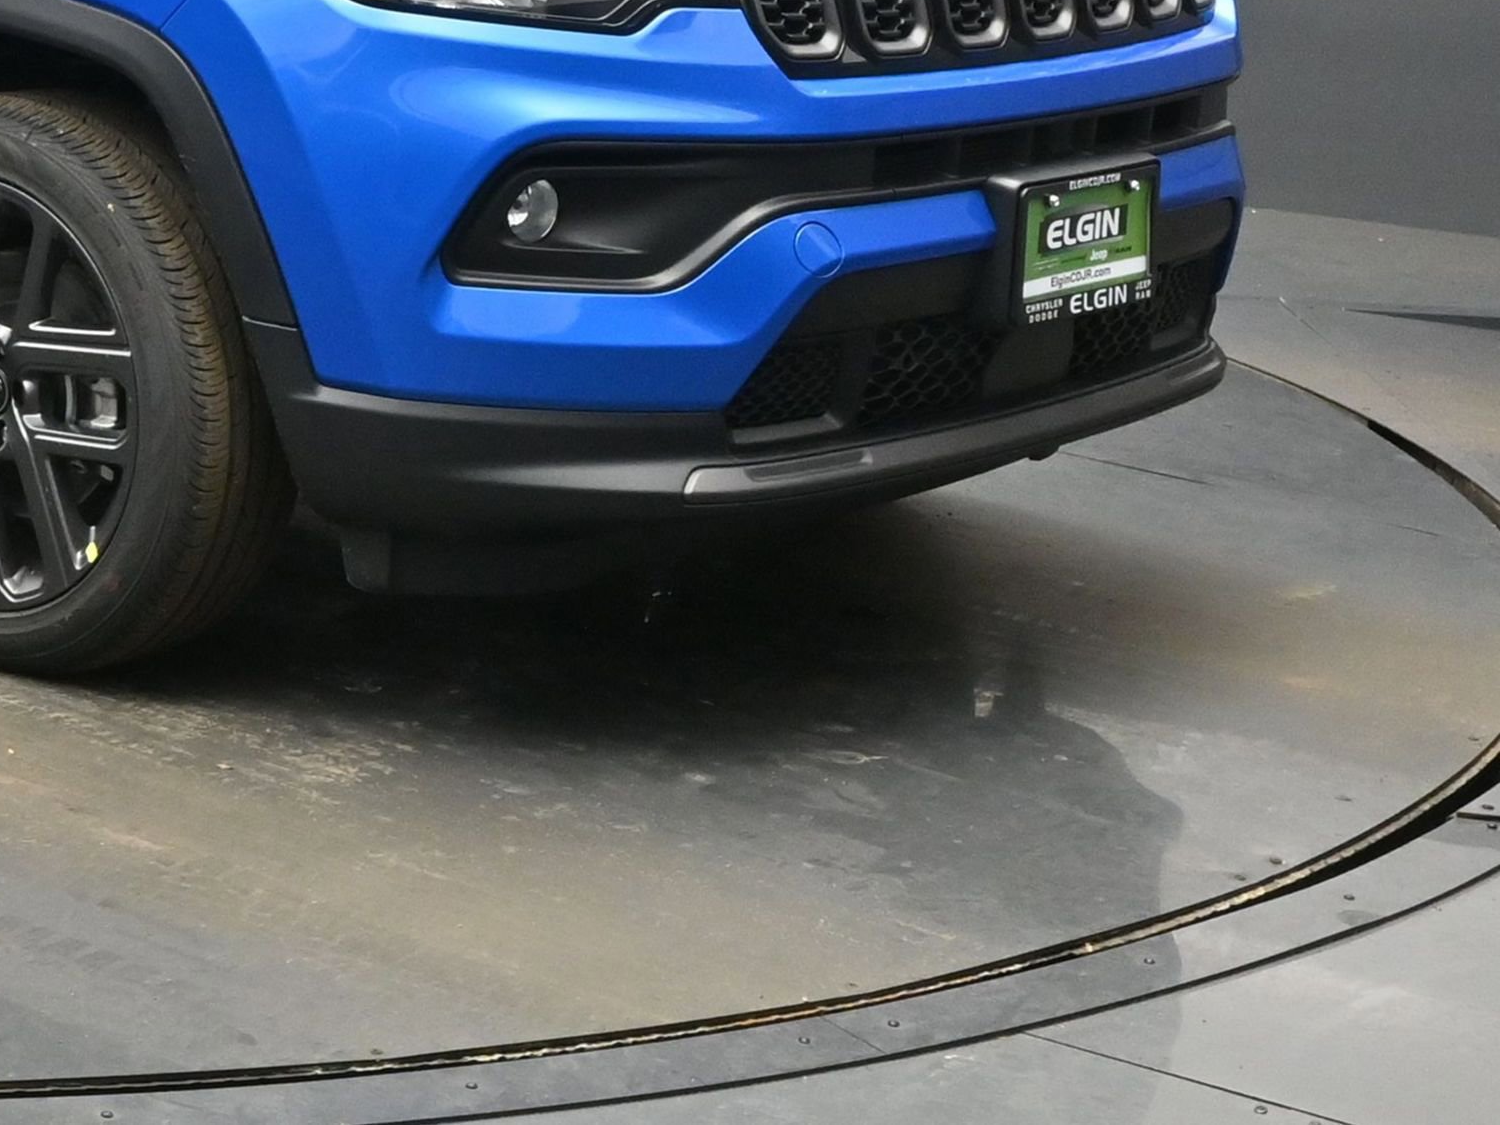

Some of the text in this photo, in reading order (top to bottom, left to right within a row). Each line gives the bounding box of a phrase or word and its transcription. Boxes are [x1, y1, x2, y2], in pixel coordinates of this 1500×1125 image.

[1046, 207, 1120, 249] ELGIN
[1051, 266, 1111, 289] ElginCDJR.com
[1025, 298, 1063, 314] CHRYSLER
[1070, 284, 1128, 314] ELGIN
[1029, 310, 1059, 323] DODGE
